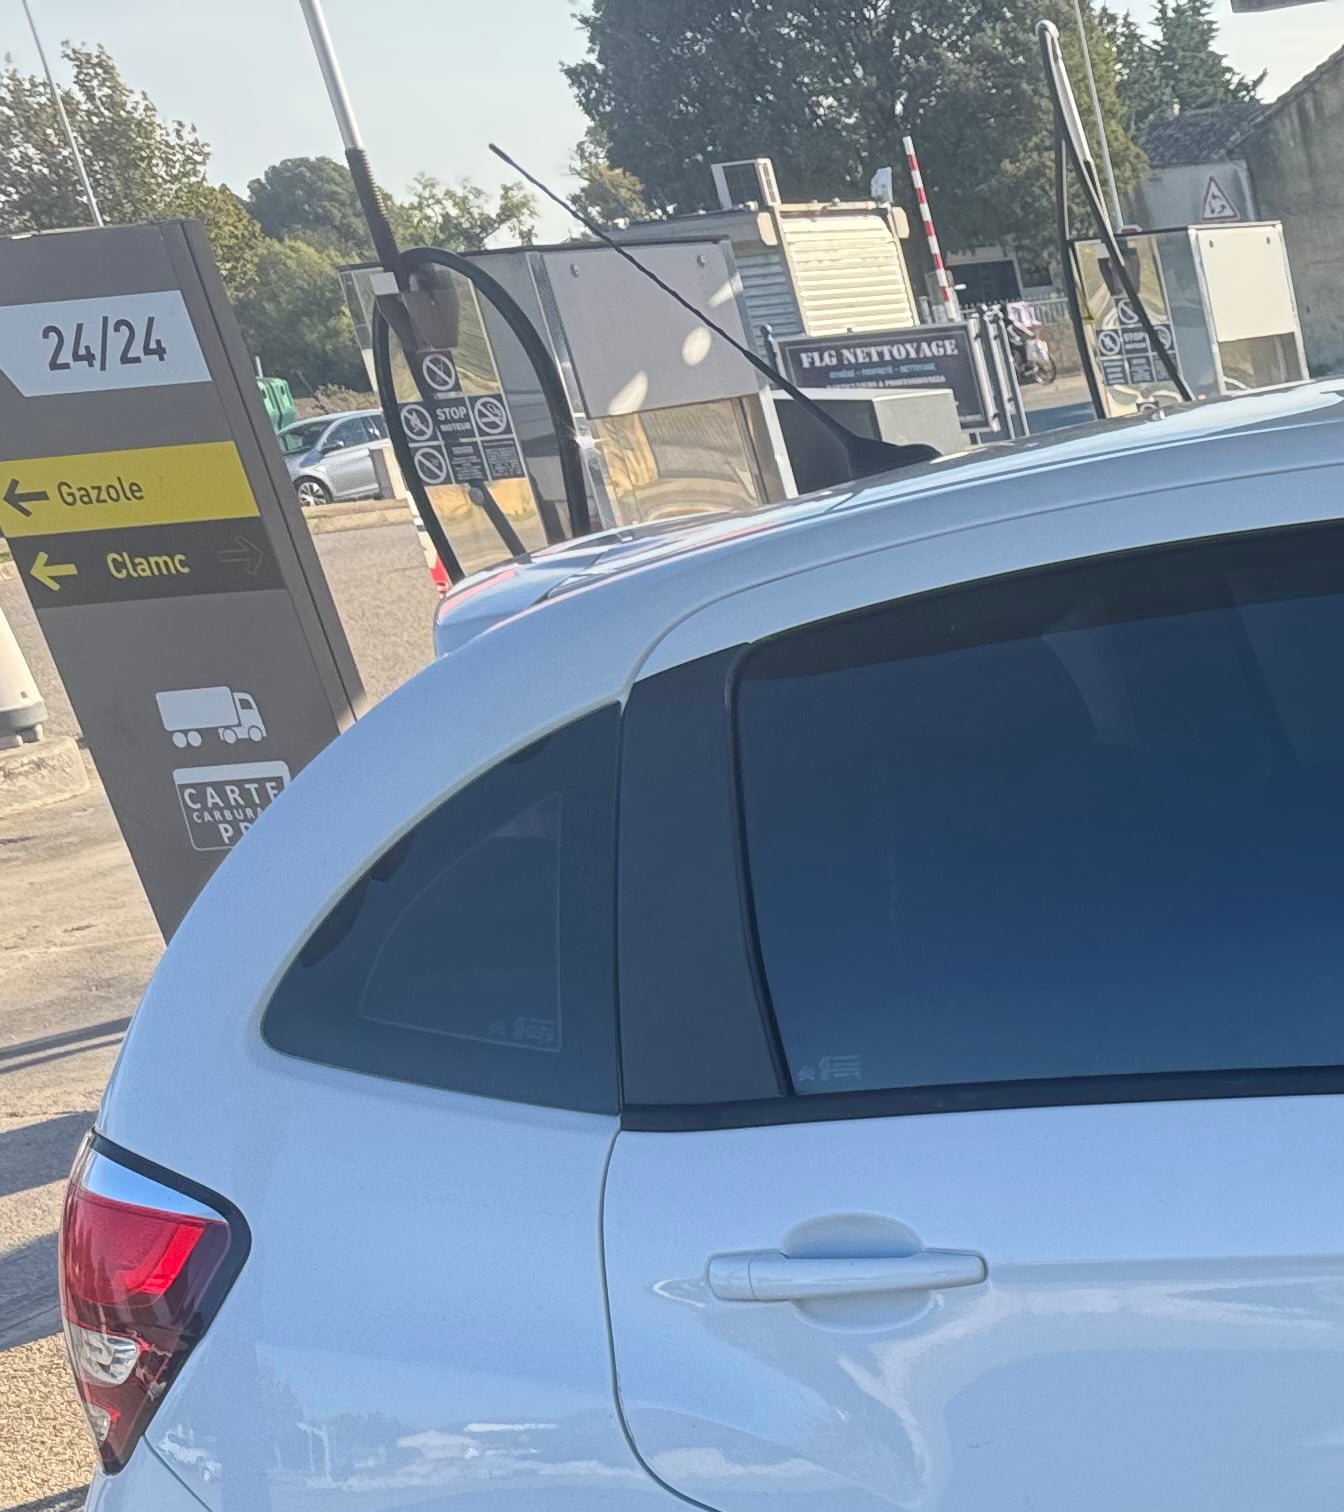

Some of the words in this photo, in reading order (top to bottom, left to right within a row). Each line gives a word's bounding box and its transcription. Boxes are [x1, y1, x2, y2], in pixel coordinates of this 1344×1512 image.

[42, 315, 167, 371] 24/24
[799, 349, 837, 369] FLG
[840, 339, 959, 366] NETTOYAGE
[436, 406, 467, 420] STOP
[57, 476, 145, 506] Gazole
[106, 551, 190, 579] Clamc
